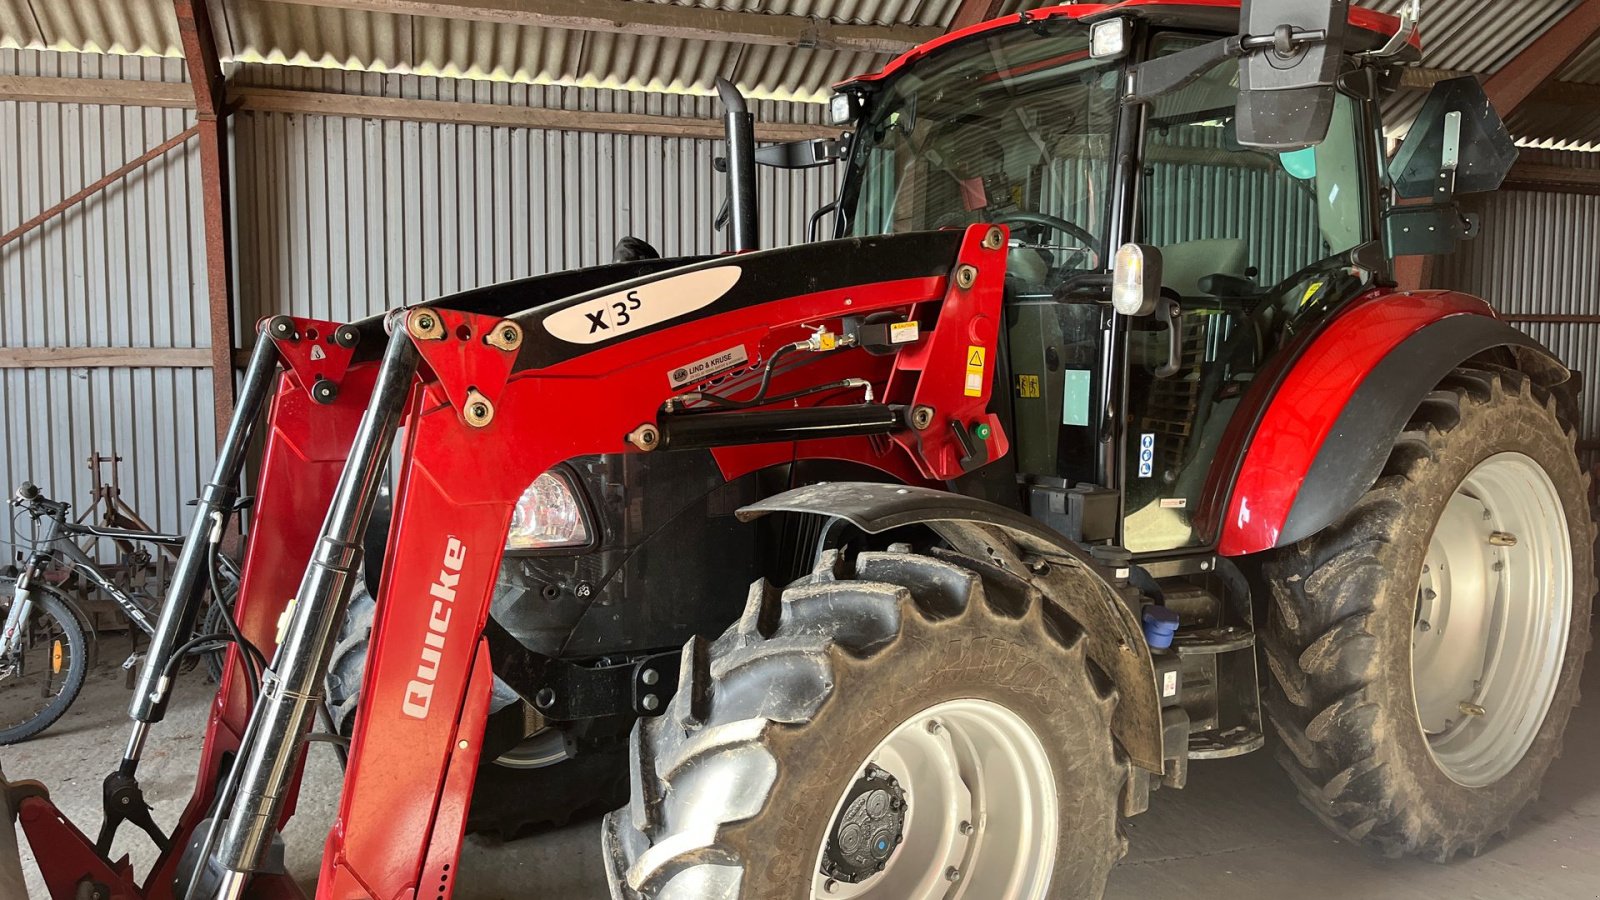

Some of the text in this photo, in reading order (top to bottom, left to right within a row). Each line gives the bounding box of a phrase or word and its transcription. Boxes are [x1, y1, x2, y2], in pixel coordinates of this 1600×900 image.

[688, 364, 704, 375] LIND
[705, 361, 710, 369] &
[710, 353, 732, 367] KRUSE
[402, 536, 467, 719] Quicke
